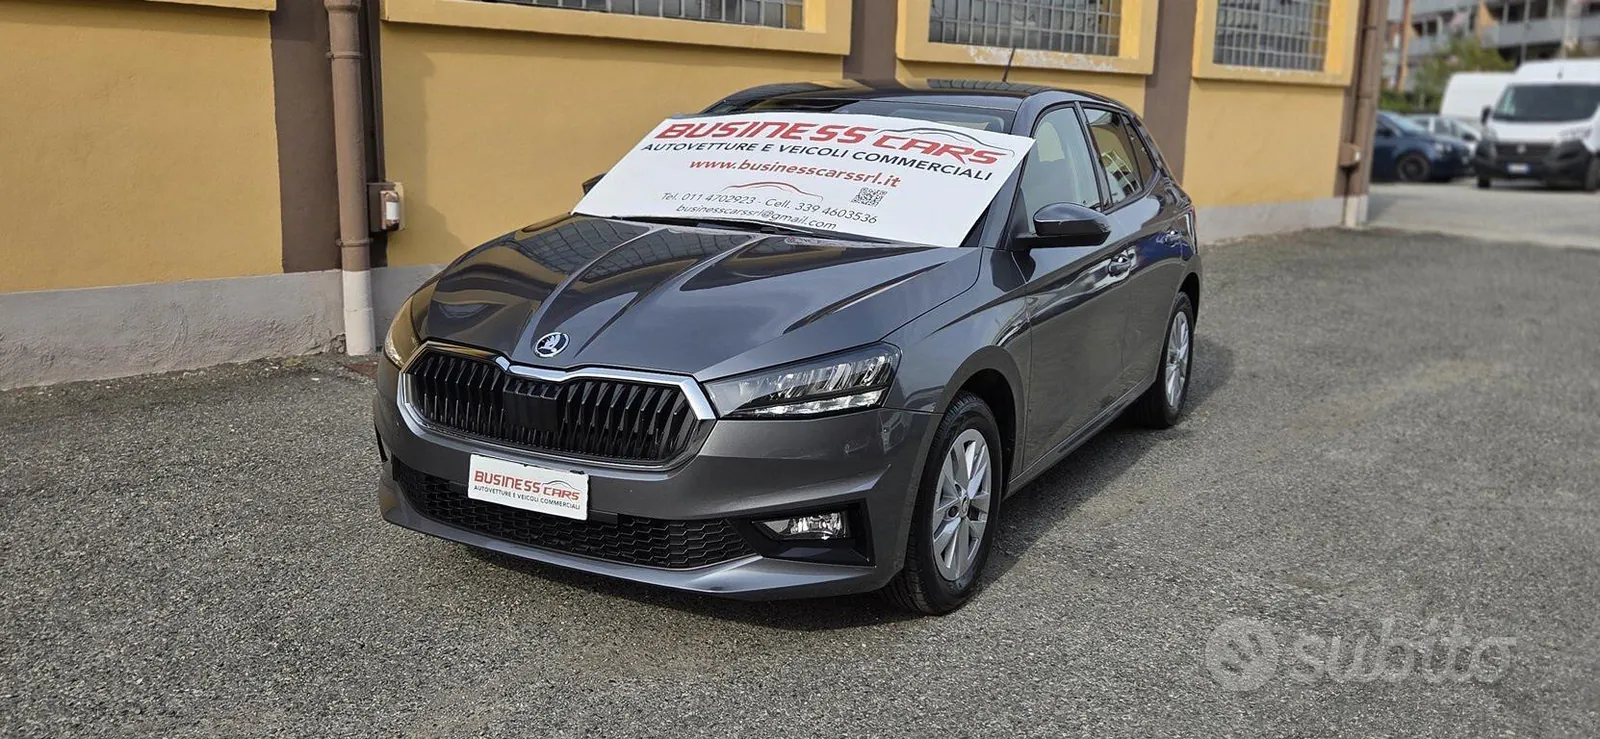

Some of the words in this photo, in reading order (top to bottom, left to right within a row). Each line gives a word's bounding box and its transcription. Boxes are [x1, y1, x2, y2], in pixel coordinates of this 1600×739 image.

[654, 121, 877, 144] BUSINESS
[872, 135, 1006, 164] CARS
[641, 142, 758, 151] AUTOVETTURE
[778, 144, 848, 158] VEICOLI
[853, 152, 992, 181] COMMERCIALI
[689, 159, 902, 188] www.businesscarssrl.it
[662, 192, 678, 201] Tel.
[682, 193, 705, 202] 011
[705, 195, 757, 206] 4702923
[765, 198, 791, 209] Cell.
[794, 202, 820, 213] 339
[822, 206, 877, 224] 4603536
[676, 204, 837, 230] businesscarssrl@gmail.com
[474, 470, 541, 493] BUSINESS
[543, 486, 580, 502] CARS
[474, 485, 512, 497] AUTOVETTURE
[517, 494, 539, 502] VEICOLI
[540, 498, 580, 509] COMMERCIALI
